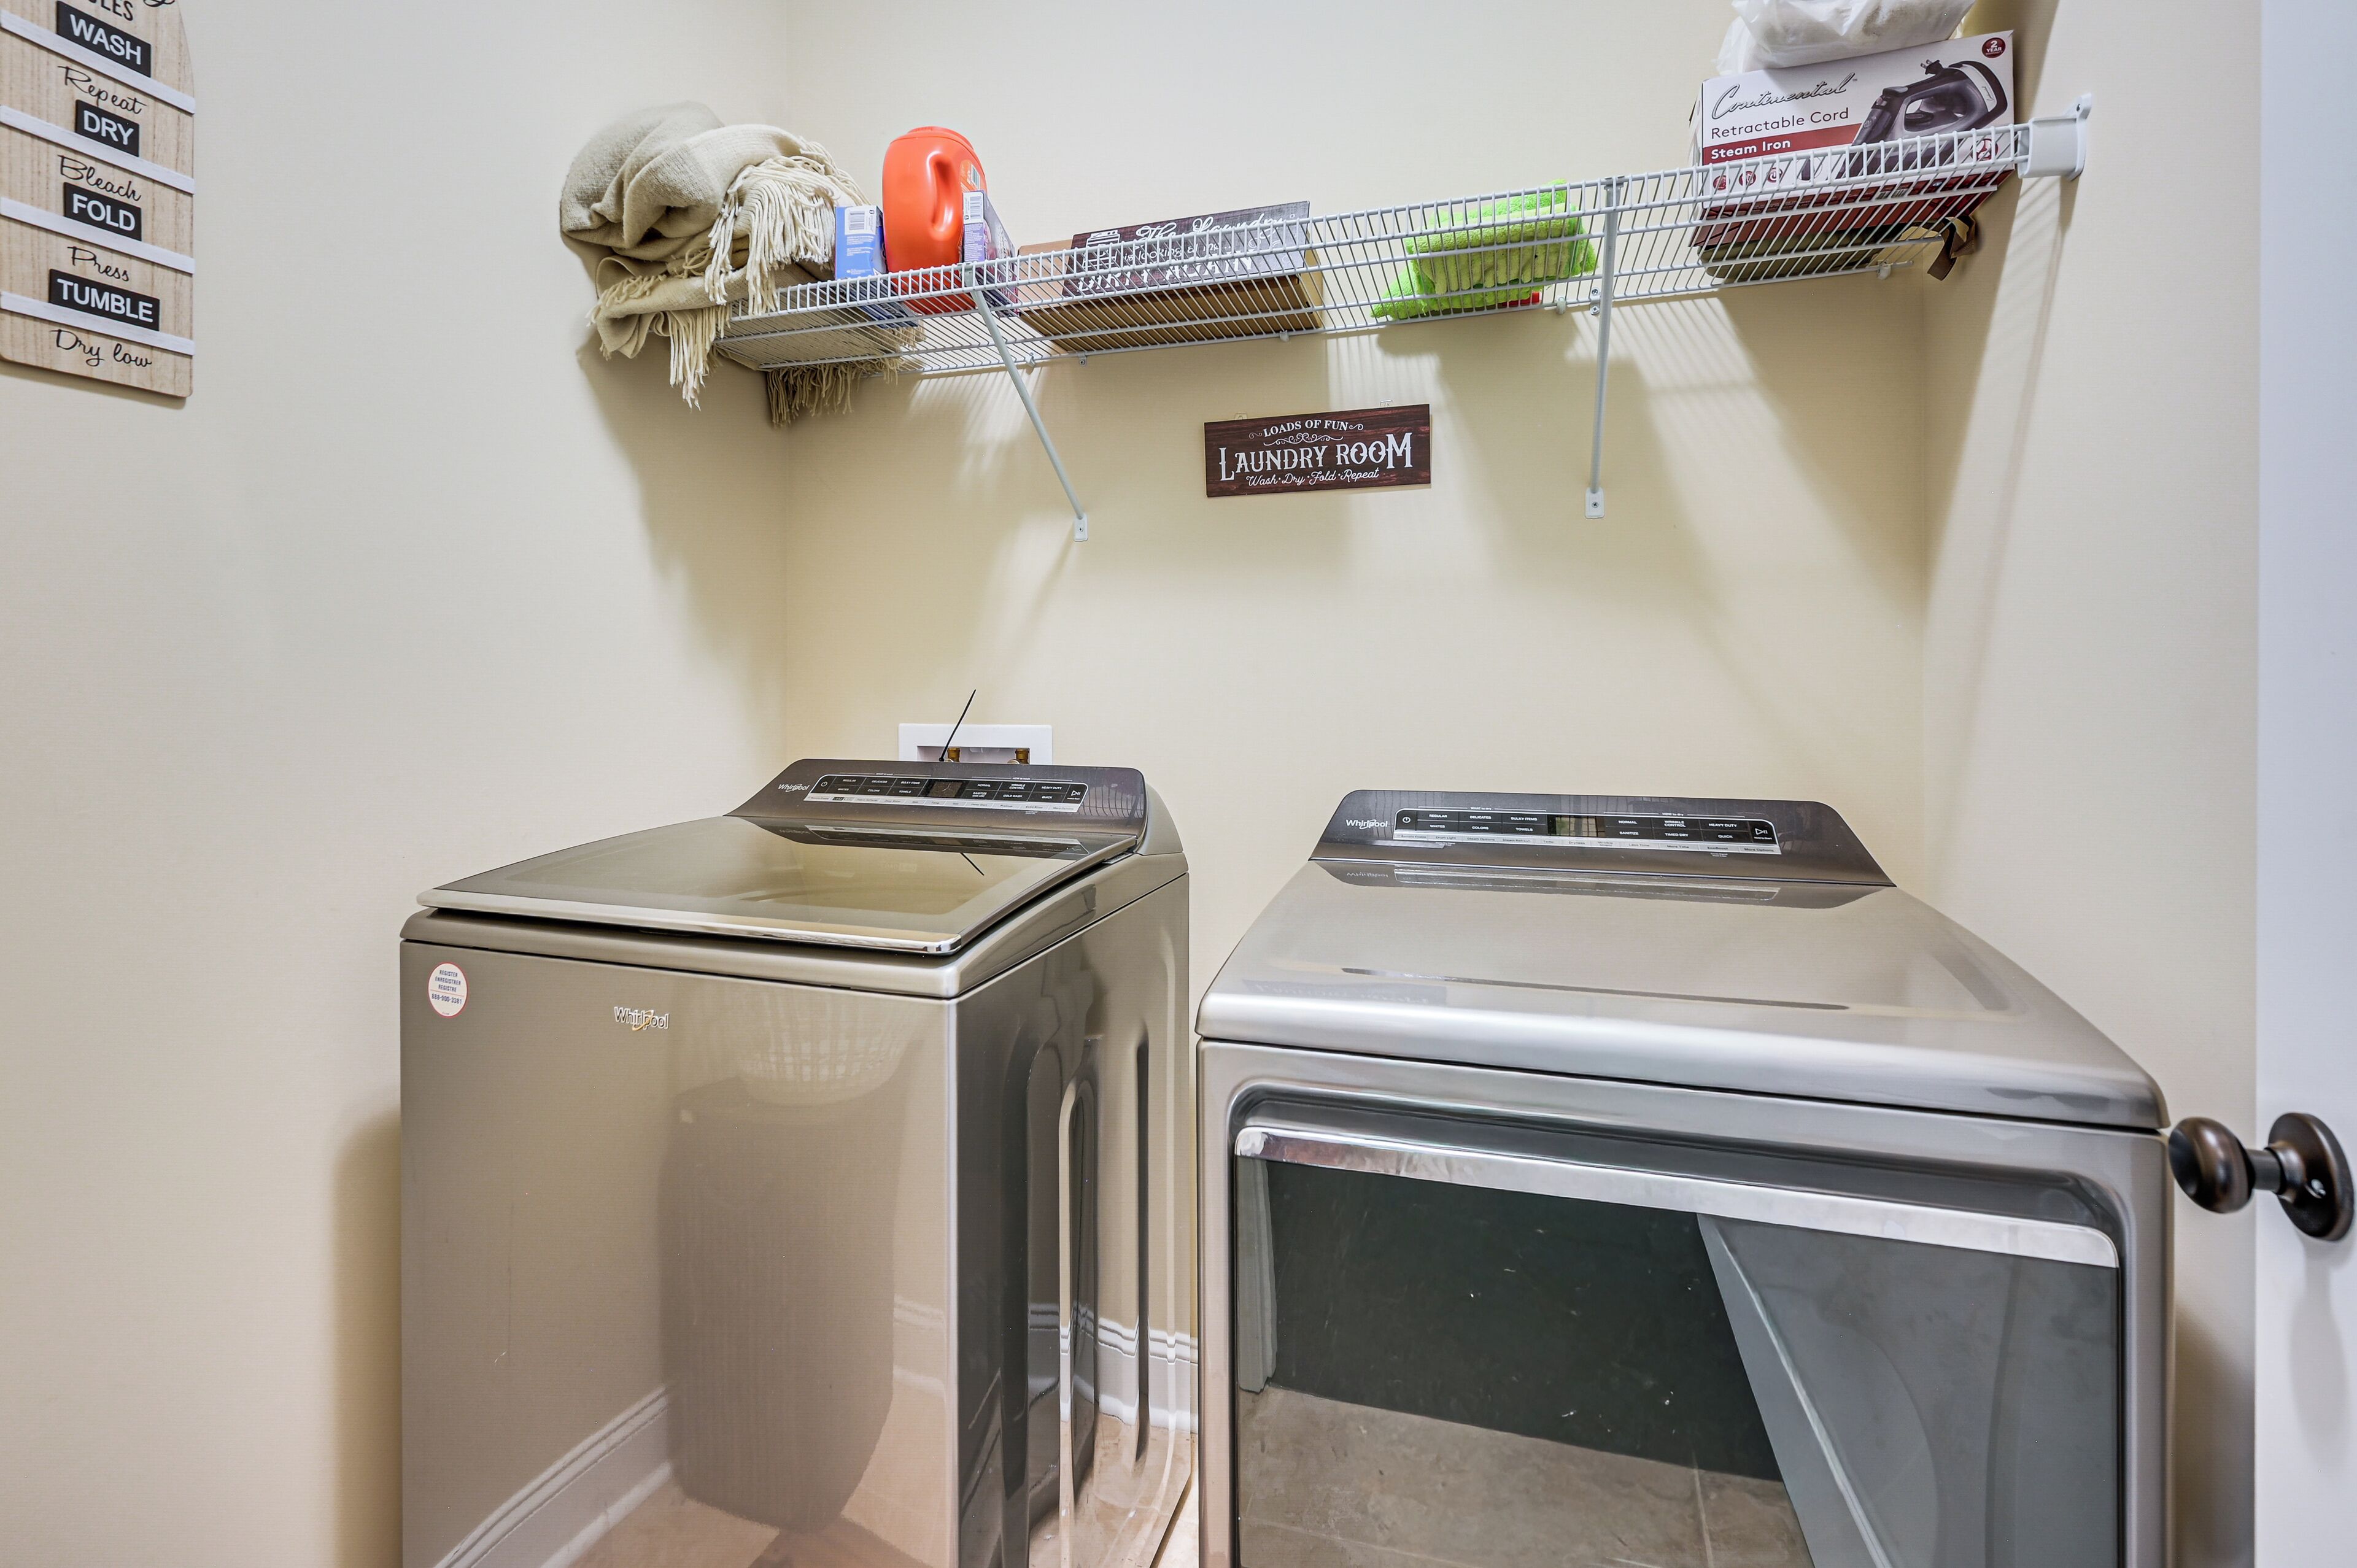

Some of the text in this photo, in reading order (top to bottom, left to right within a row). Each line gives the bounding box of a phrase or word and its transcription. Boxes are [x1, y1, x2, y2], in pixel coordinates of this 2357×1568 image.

[88, 0, 133, 21] LES
[69, 14, 142, 65] WASH
[57, 65, 147, 114] Repeat
[1711, 71, 1856, 120] Continental
[83, 110, 134, 145] DRY
[1711, 107, 1849, 139] Retractable Cord
[1711, 139, 1790, 160] Steam Iron
[57, 155, 142, 202] Bleach
[72, 193, 136, 231] FOLD
[67, 246, 130, 282] Press
[56, 278, 153, 323] TUMBLE
[50, 329, 152, 368] Dry low
[1263, 420, 1350, 437] LOADS OF FUN
[1218, 432, 1413, 481] LAUNDRY ROOM
[778, 783, 810, 792] Whirlpool
[1345, 819, 1388, 830] Whirlpool
[613, 1006, 670, 1032] Whirlpool
